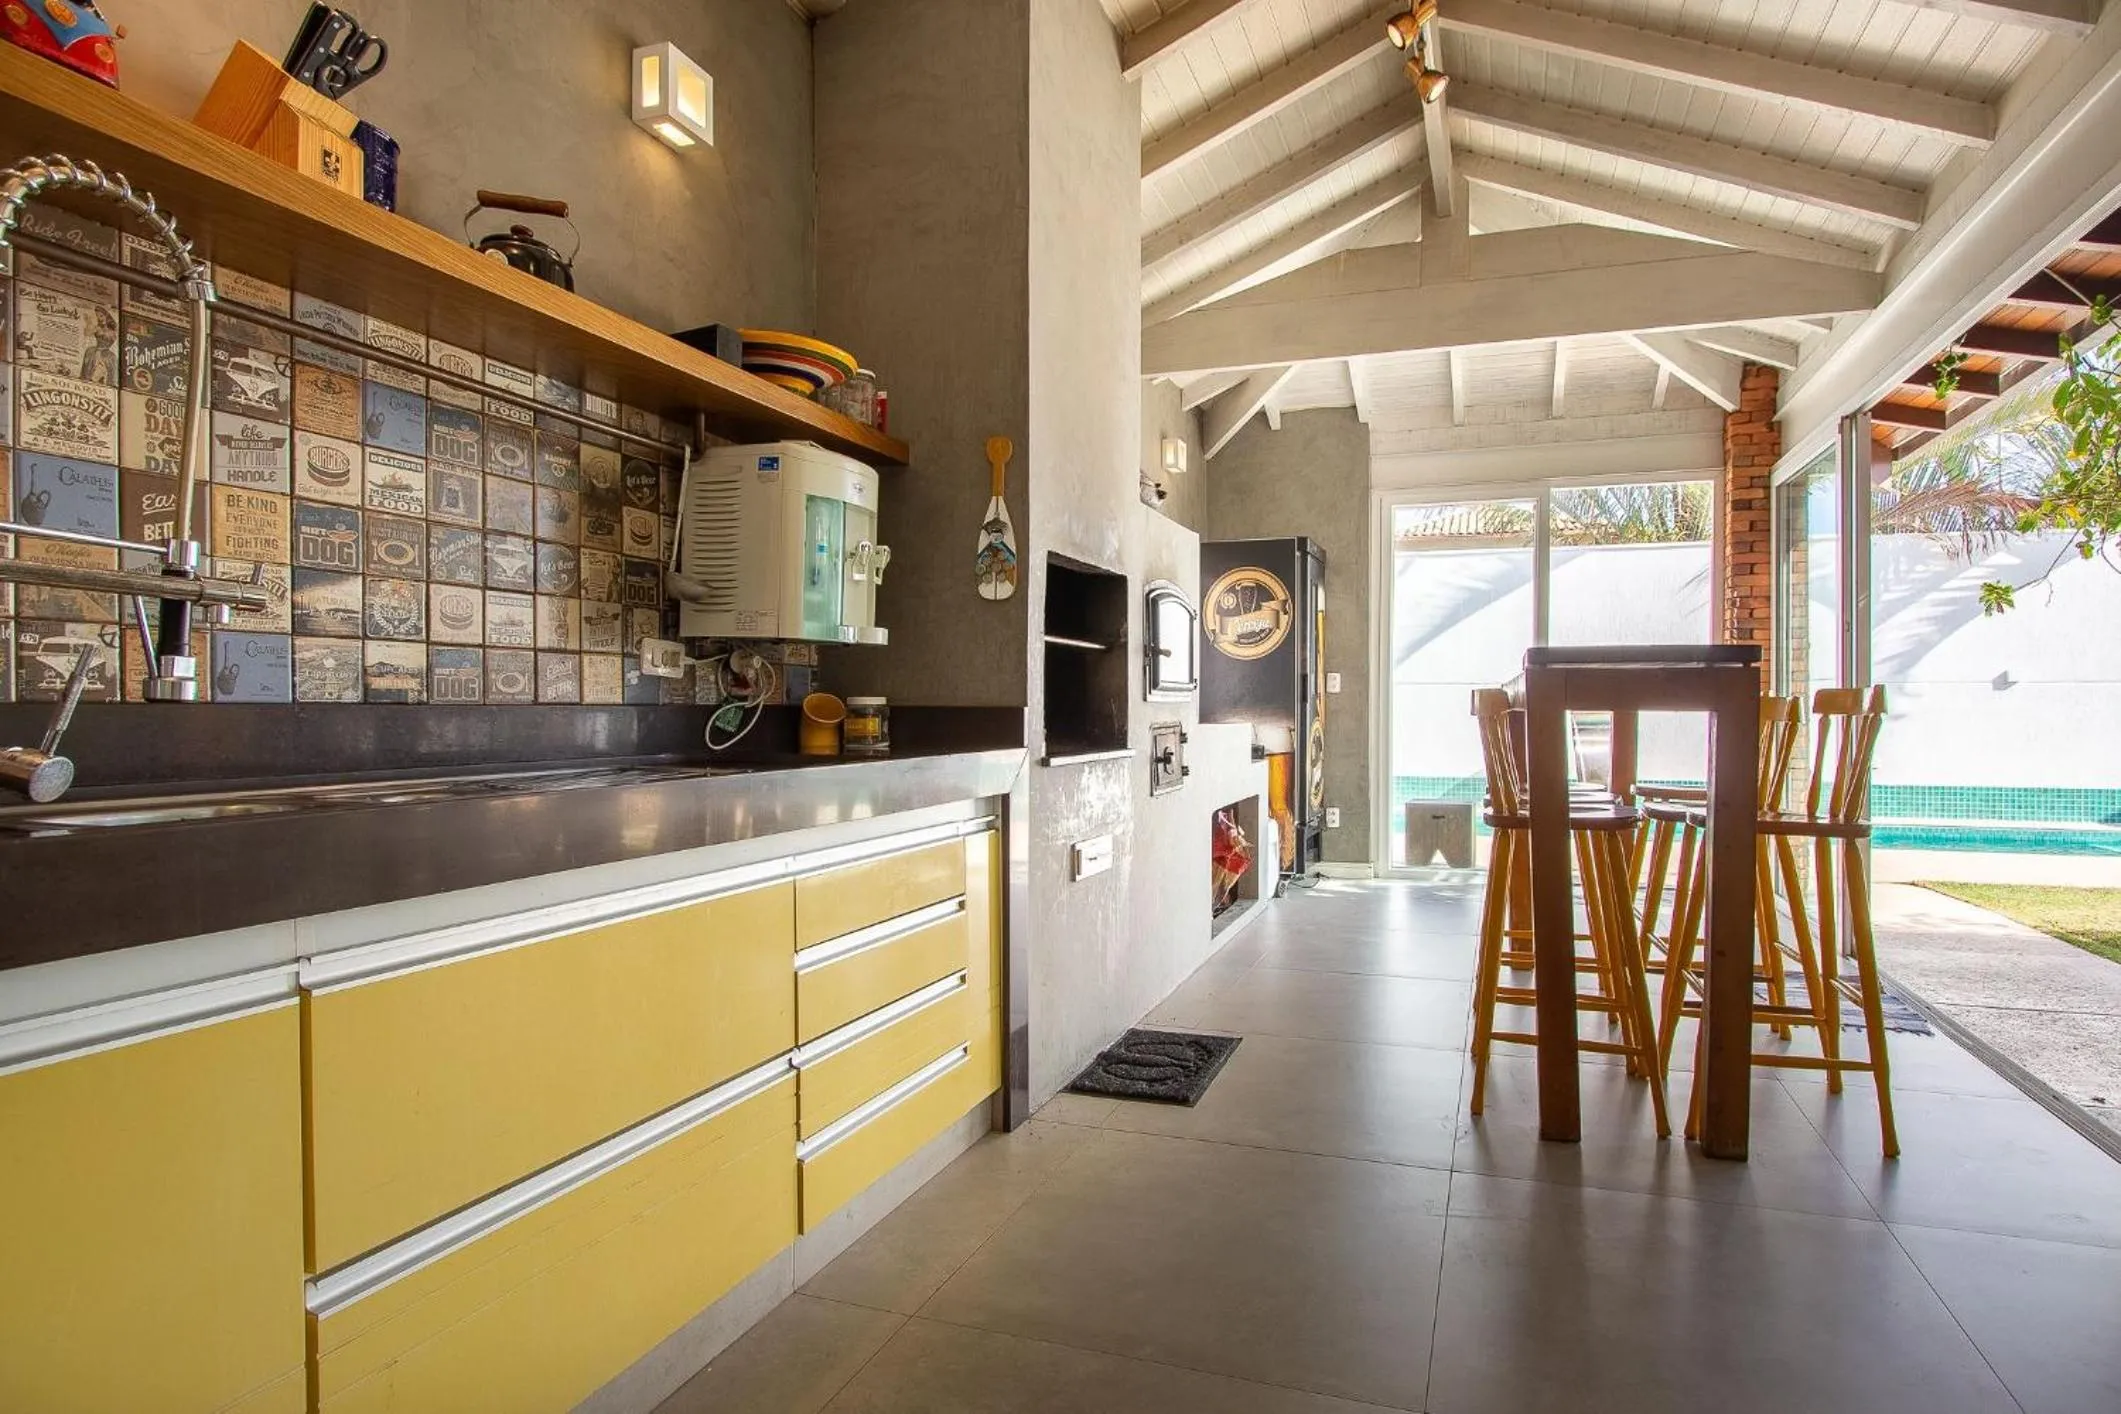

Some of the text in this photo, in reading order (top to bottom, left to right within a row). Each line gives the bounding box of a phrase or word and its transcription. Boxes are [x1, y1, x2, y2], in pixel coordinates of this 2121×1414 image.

[432, 432, 479, 466] DOG
[227, 470, 278, 483] HANDLE
[226, 494, 278, 514] BE KIND
[369, 498, 423, 514] FOOD
[226, 512, 279, 530] EVERYONE
[226, 535, 279, 550] FIGHTING
[300, 534, 357, 567] DOG
[433, 675, 479, 701] DOG
